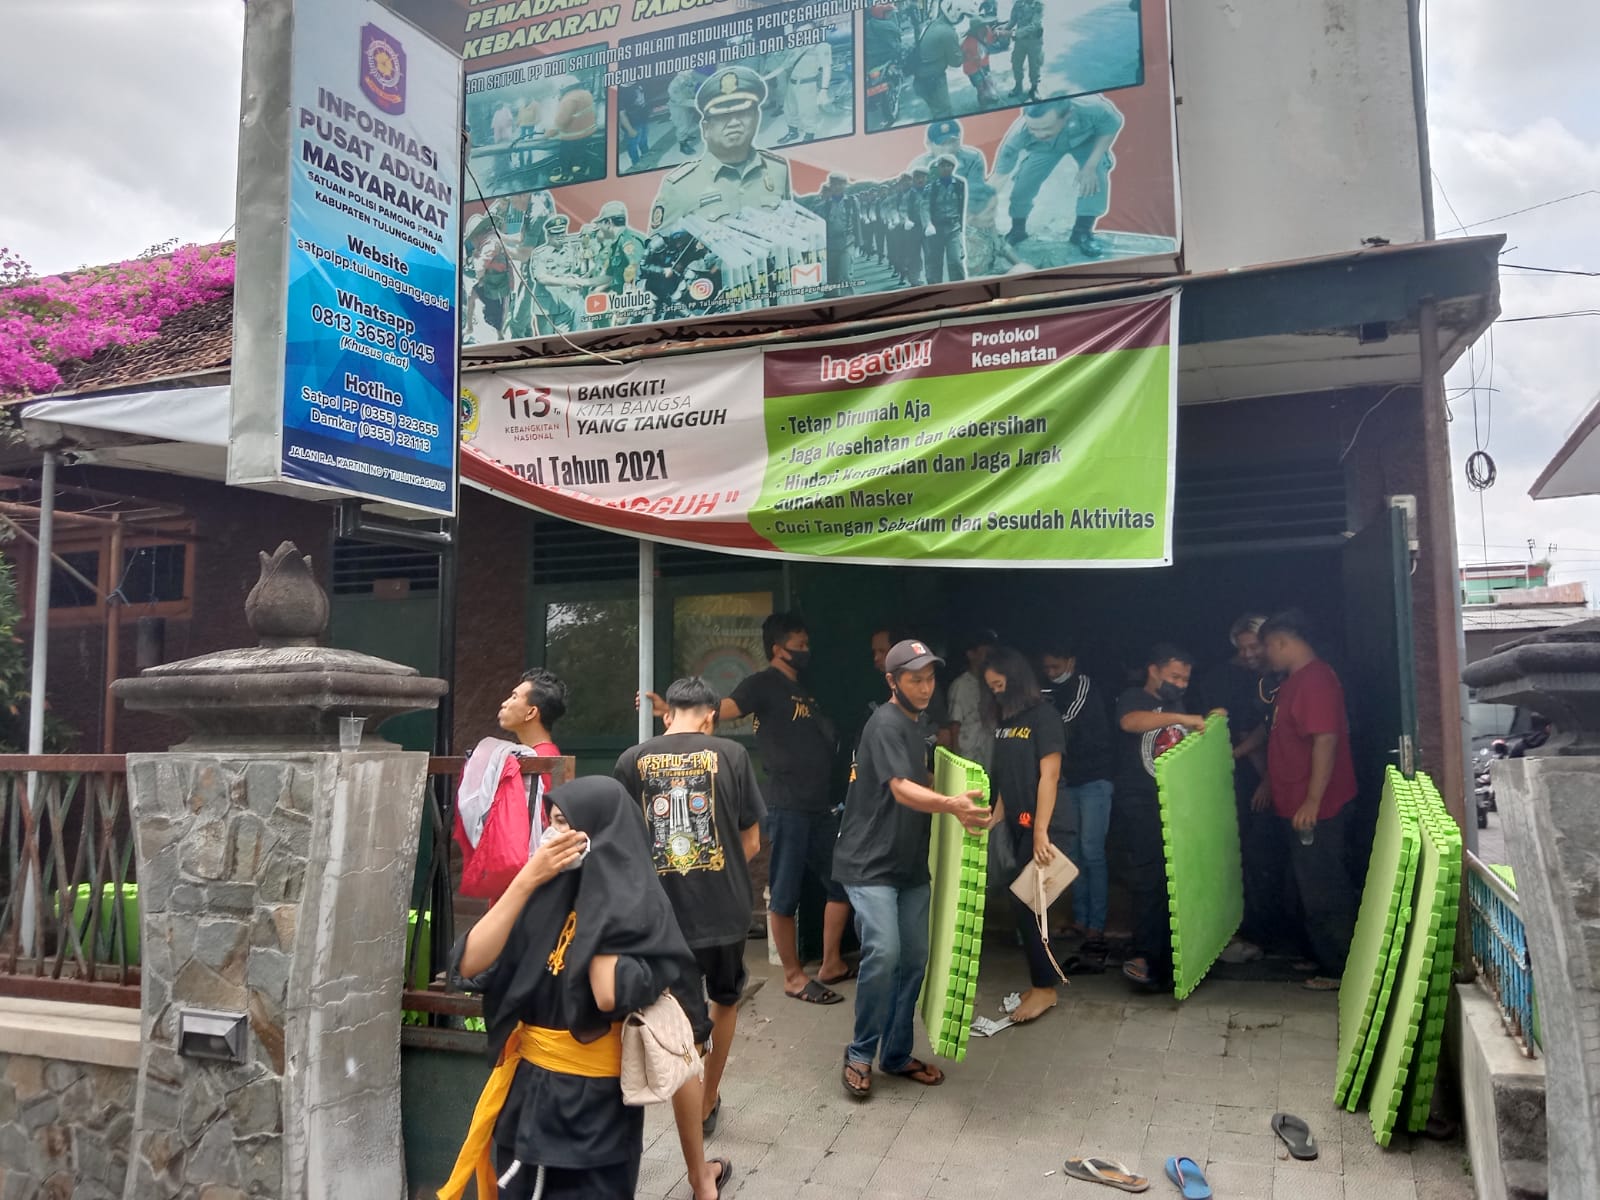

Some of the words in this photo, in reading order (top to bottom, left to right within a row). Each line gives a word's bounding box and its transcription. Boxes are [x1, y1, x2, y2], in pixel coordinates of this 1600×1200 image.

[463, 6, 620, 59] KEBAKARAN
[632, 0, 729, 21] PAMO
[487, 72, 525, 92] SATPOL
[528, 66, 542, 81] PP
[544, 60, 567, 78] DAN
[569, 45, 632, 73] SATLINMAS
[635, 36, 676, 58] DALAM
[678, 18, 753, 47] MENDUKUNG
[757, 2, 838, 31] PENCEGAHAN
[604, 66, 652, 88] MENUJU
[655, 51, 717, 79] INDONESIA
[720, 42, 756, 64] MAJU
[758, 35, 784, 55] DAN
[318, 86, 438, 171] INFORMASI
[300, 107, 375, 163] PUSAT
[379, 152, 452, 205] ADUAN
[303, 140, 449, 230] MASYARAKAT
[307, 171, 346, 196] SATUAN
[348, 190, 377, 211] POLISI
[378, 204, 416, 230] PAMONG
[417, 224, 444, 244] PRAJA
[315, 191, 371, 224] KABUPATEN
[373, 218, 437, 255] TULUNGAGUNG
[297, 238, 450, 311] satpolpp.tulungagung.go.id
[347, 234, 409, 275] Website
[337, 289, 415, 335] Whatsapp
[608, 290, 651, 310] YouTube
[312, 305, 351, 333] 0813
[356, 320, 396, 350] 3658
[400, 339, 435, 363] 0145
[340, 336, 382, 361] (Khusus
[384, 349, 409, 371] chat)
[971, 325, 1040, 347] Protokol
[820, 339, 932, 383] Ingat!!!!
[971, 346, 1057, 368] Kesehatan
[345, 373, 403, 406] Hotline
[576, 401, 614, 417] KITA
[620, 395, 691, 415] BANGSA
[577, 379, 665, 401] BANGKIT!
[302, 387, 340, 410] Satpol
[343, 397, 359, 413] PP
[360, 403, 397, 428] (0355)
[399, 414, 439, 437] 323655
[311, 408, 357, 433] Damkar
[359, 421, 396, 447] (0355)
[396, 432, 431, 452] 321113
[505, 423, 560, 433] KEBANGKITAN
[577, 418, 626, 435] YANG
[633, 408, 727, 430] TANGGUH
[788, 412, 832, 435] Tetap
[836, 407, 899, 430] Dirumah
[903, 400, 931, 423] Aja
[514, 433, 554, 441] NASIONAL
[788, 448, 821, 465] Jaga
[826, 434, 910, 459] Kesehatan
[914, 429, 944, 447] dan
[289, 446, 319, 462] JALAN
[336, 457, 370, 474] KARTINI
[383, 470, 389, 478] 7
[390, 470, 447, 492] TULUNGAGUNG
[549, 455, 610, 486] Tahun
[616, 449, 668, 482] 2021
[784, 469, 839, 491] Hindari
[933, 455, 966, 473] dan
[970, 450, 1011, 474] Jaga
[1016, 444, 1061, 468] Jarak
[850, 489, 914, 508] Masker
[775, 520, 810, 534] Cuci
[814, 519, 874, 537] Tangan
[951, 512, 982, 533] dan
[987, 507, 1064, 532] Sesudah
[1069, 507, 1155, 531] Aktivitas
